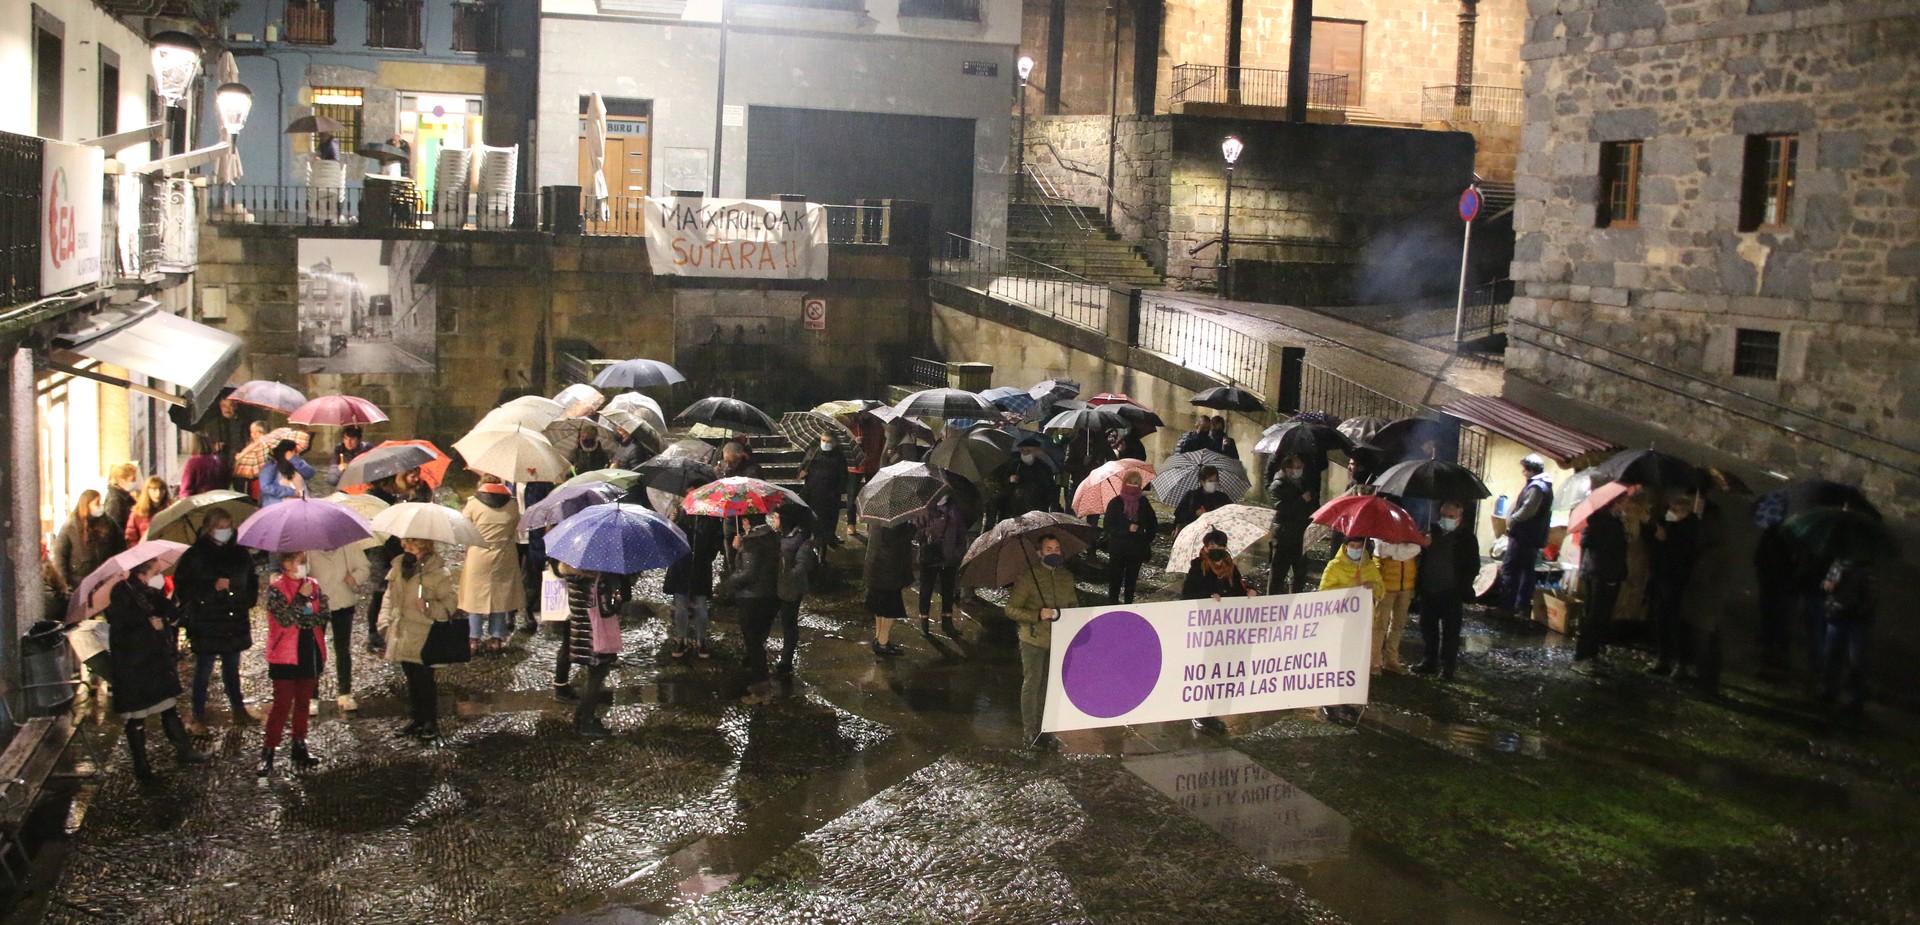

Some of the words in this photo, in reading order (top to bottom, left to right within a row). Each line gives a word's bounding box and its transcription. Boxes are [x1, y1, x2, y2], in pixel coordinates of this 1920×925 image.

[60, 205, 76, 261] EA
[1187, 604, 1289, 628] EMAKUMEEN
[1293, 596, 1361, 620] AURKAKO
[1186, 624, 1298, 649] INDARKERIARI
[1302, 622, 1320, 640] EZ
[1184, 663, 1206, 682] NO
[1211, 663, 1222, 680] A
[1227, 660, 1246, 679] LA
[1251, 651, 1328, 676] VIOLENCIA
[1182, 681, 1245, 703] CONTRA
[1249, 676, 1277, 696] LAS
[1282, 669, 1356, 692] MUJERES
